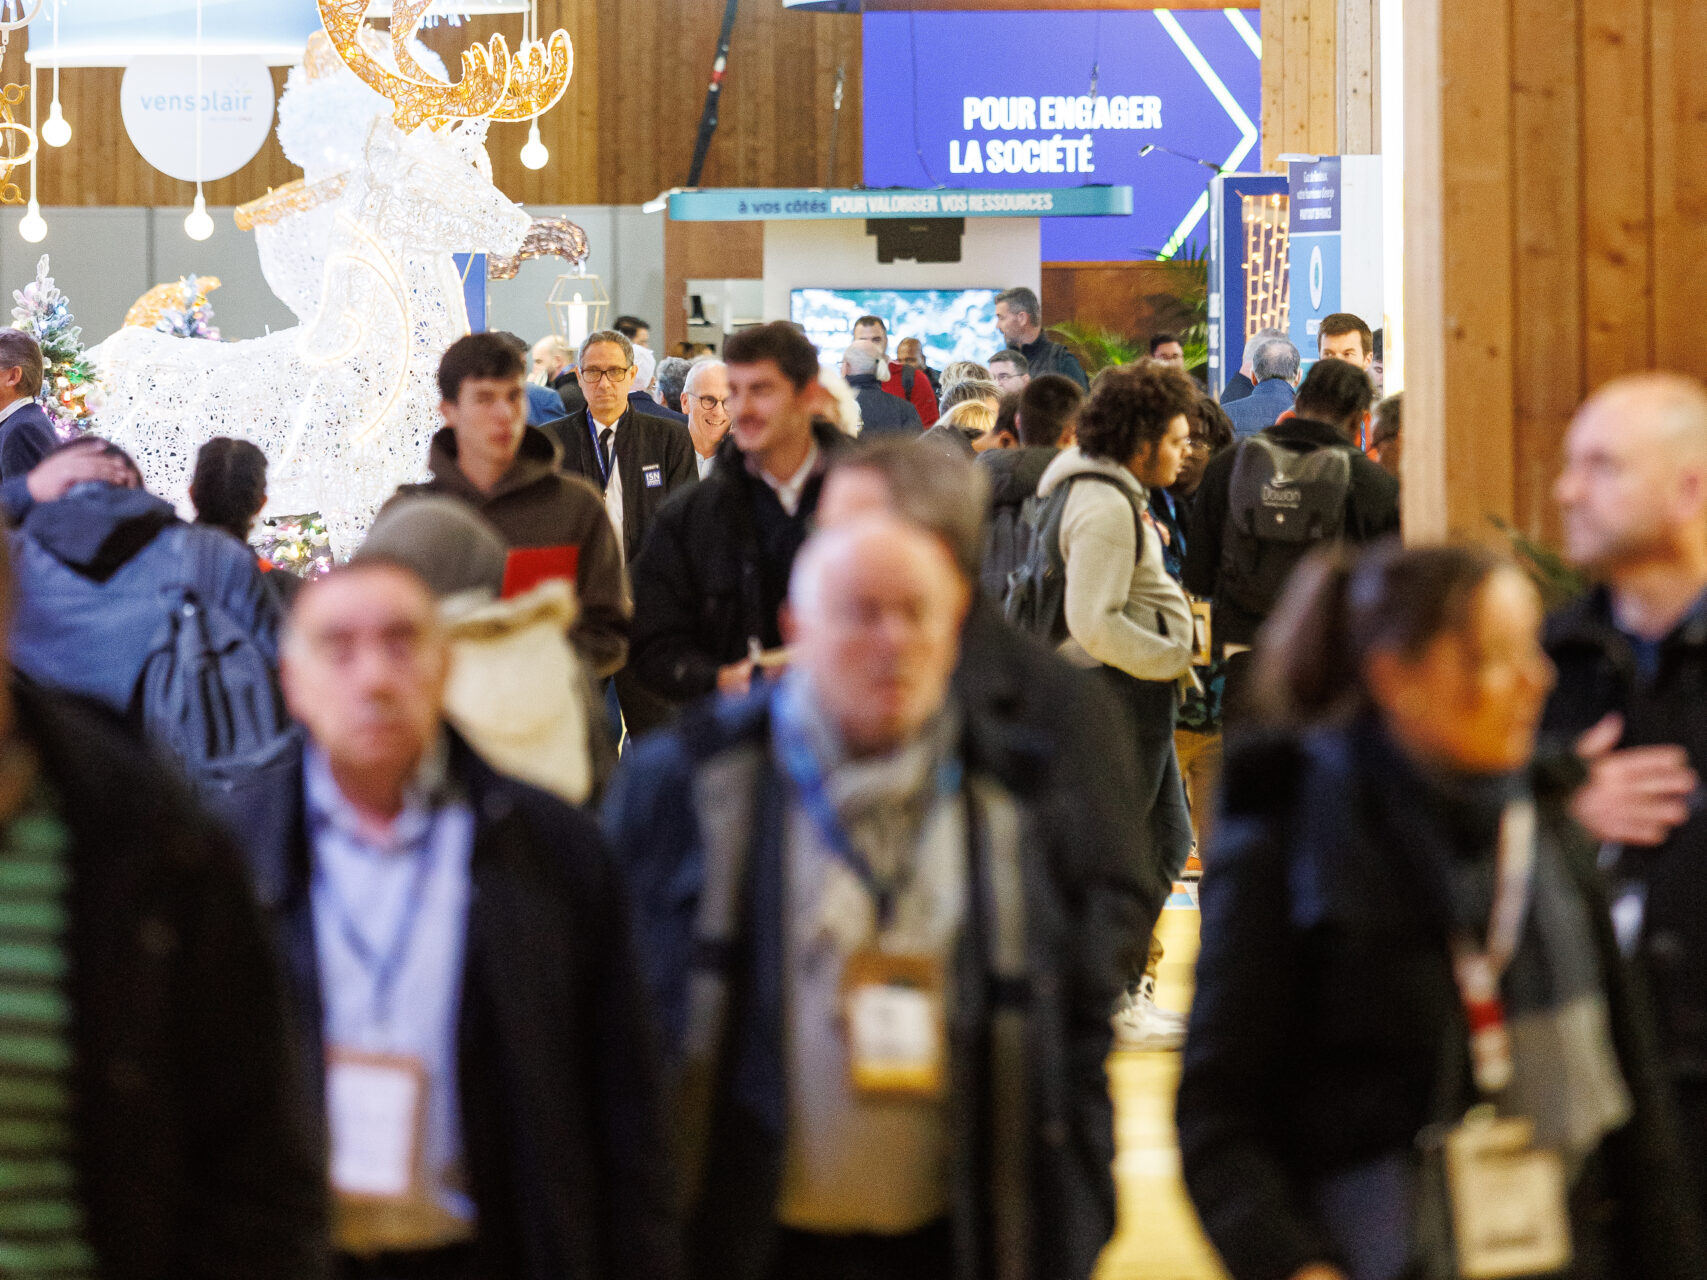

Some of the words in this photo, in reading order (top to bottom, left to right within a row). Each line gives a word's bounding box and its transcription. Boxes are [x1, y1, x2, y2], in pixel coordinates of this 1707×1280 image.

[140, 89, 253, 112] vensolair
[963, 96, 1037, 131] POUR
[1040, 95, 1162, 130] ENGAGER
[949, 139, 984, 173] LA
[985, 134, 1095, 173] SOCIÉTÉ
[738, 202, 748, 213] à
[752, 202, 781, 214] vos
[784, 200, 827, 213] côtés
[830, 195, 867, 213] POUR
[868, 195, 938, 212] VALORISER
[940, 194, 967, 211] VOS
[968, 193, 1053, 211] RESSOURCES
